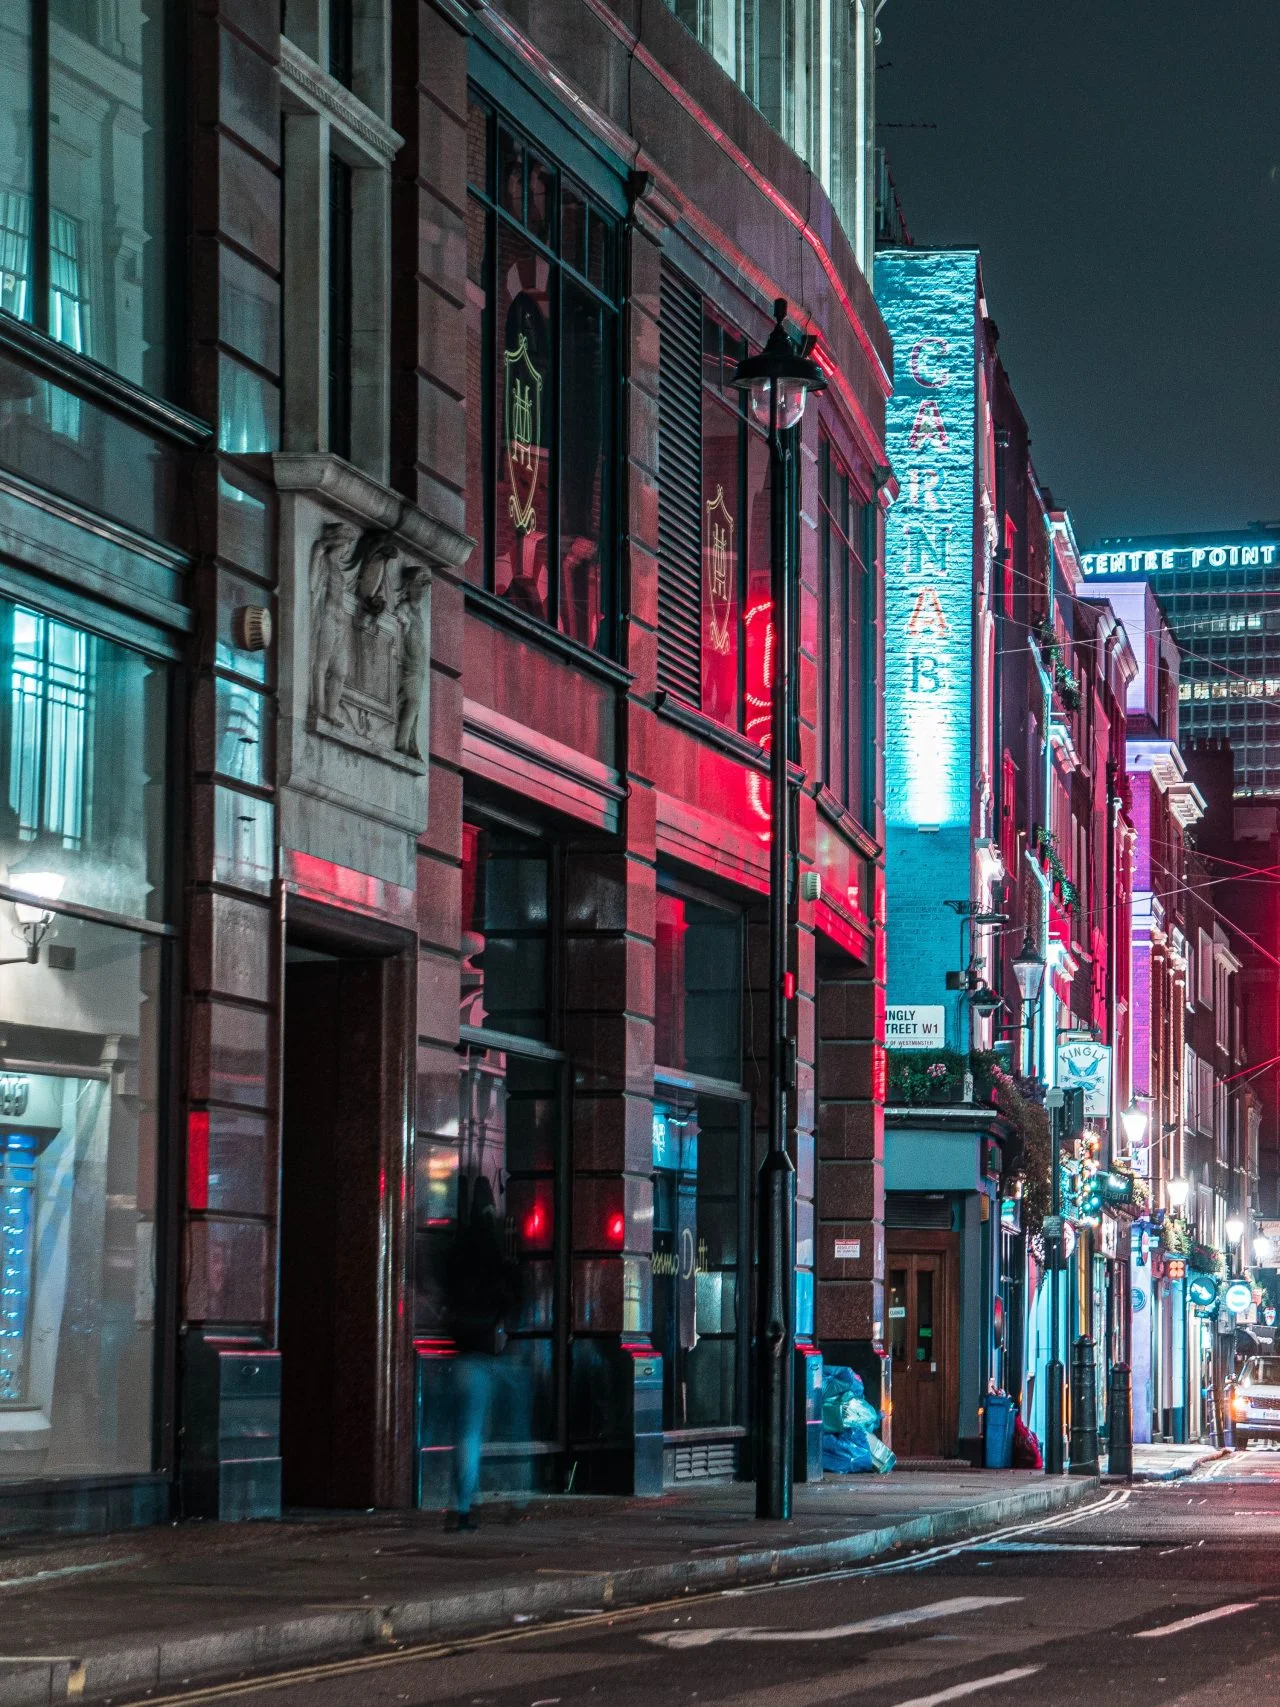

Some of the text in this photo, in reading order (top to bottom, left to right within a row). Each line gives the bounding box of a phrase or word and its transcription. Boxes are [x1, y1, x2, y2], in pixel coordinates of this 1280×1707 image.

[908, 336, 952, 762] CARNAB
[1080, 545, 1276, 576] CENTRE POINT
[922, 1023, 938, 1034] W1
[1060, 1047, 1107, 1062] KINGLY
